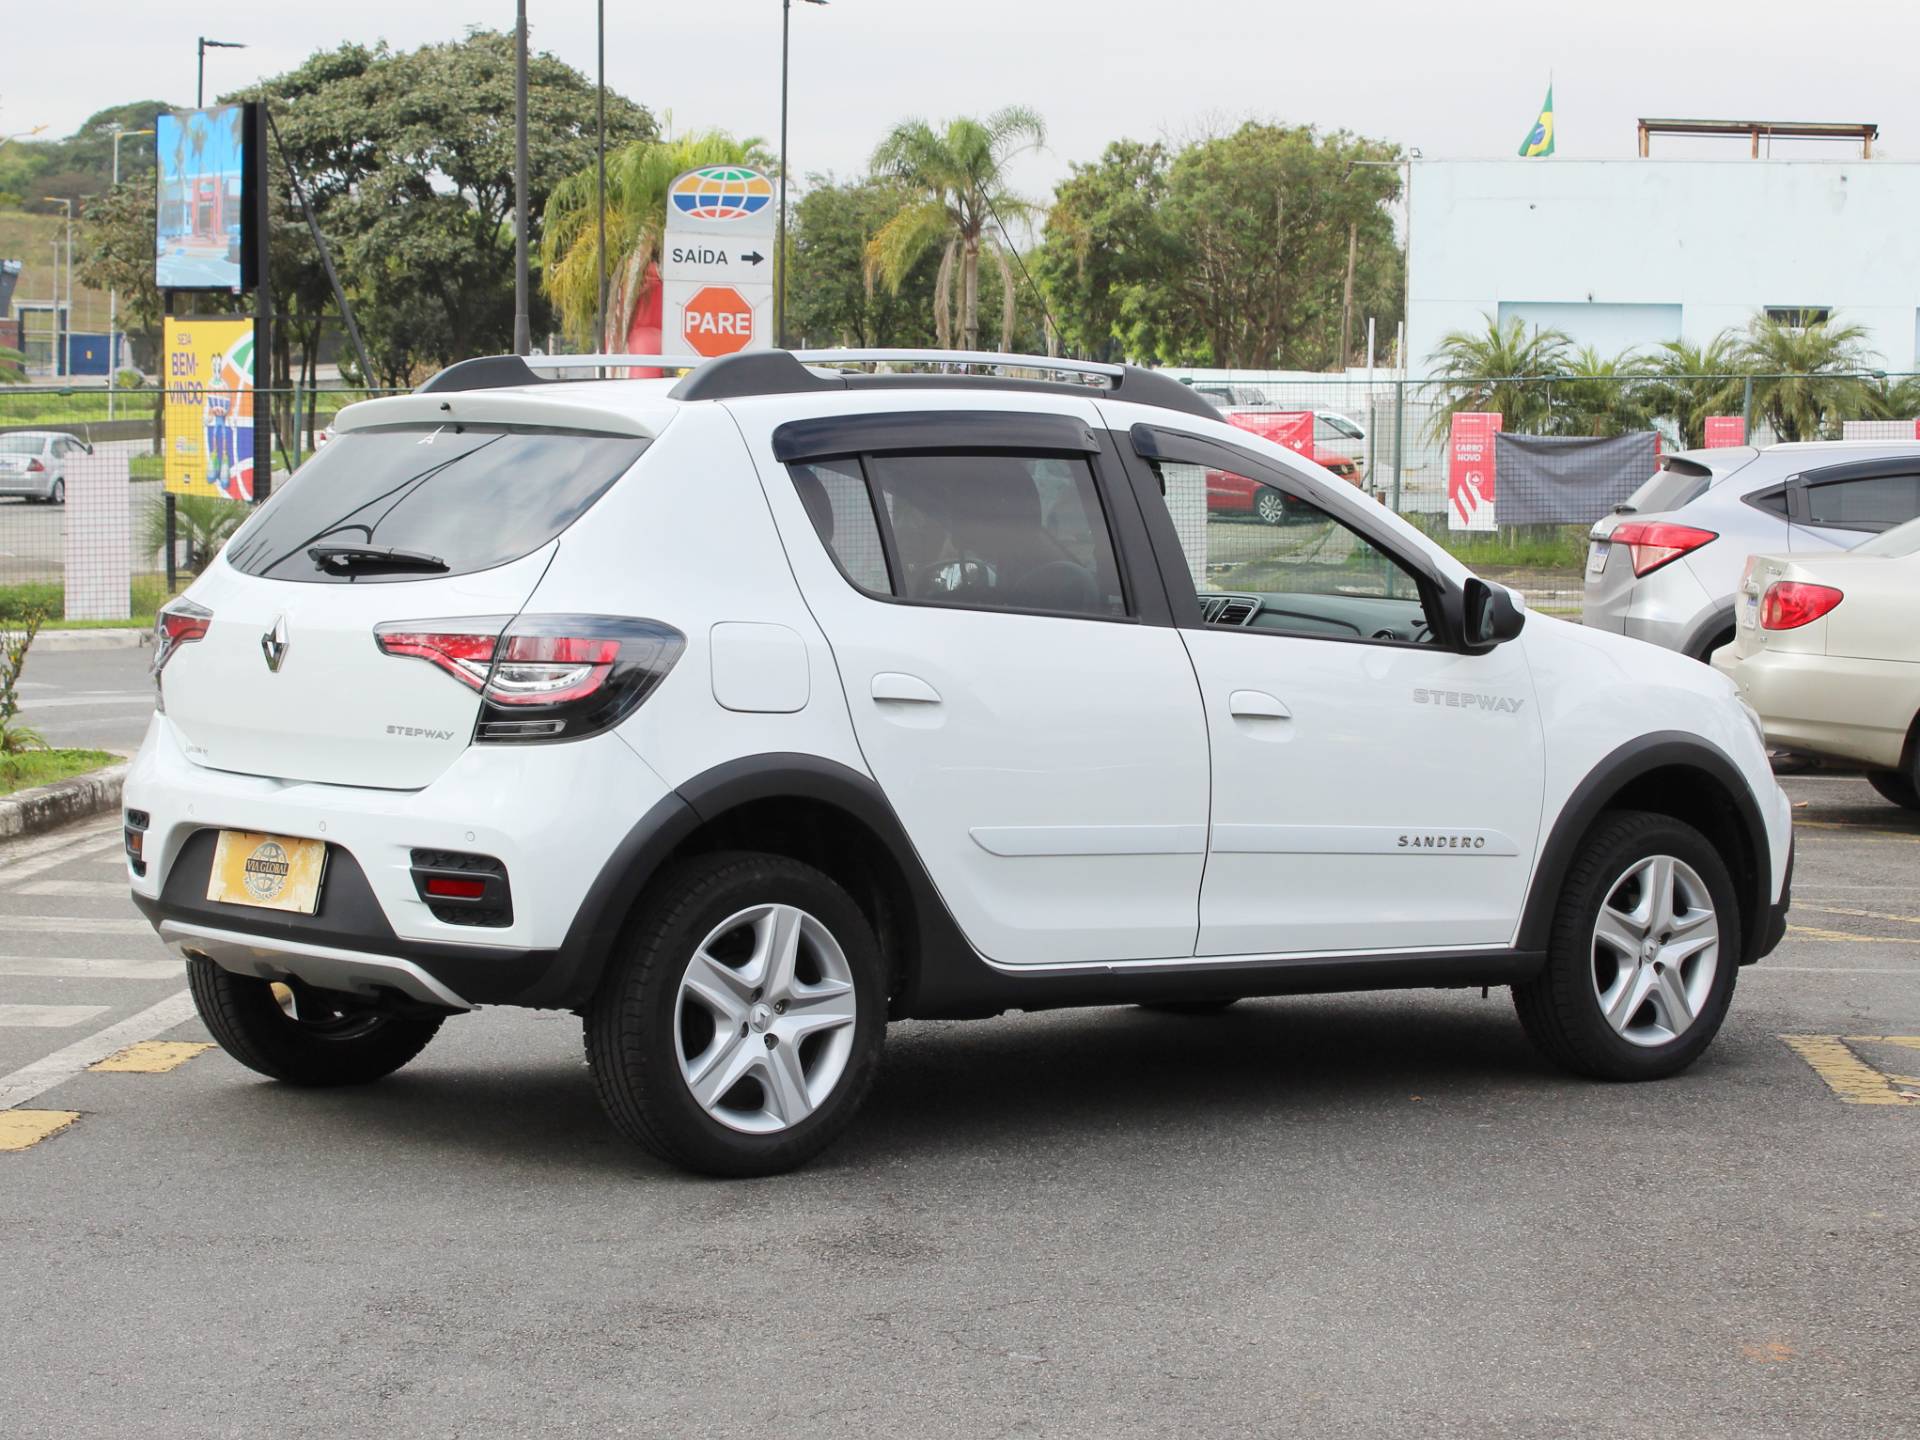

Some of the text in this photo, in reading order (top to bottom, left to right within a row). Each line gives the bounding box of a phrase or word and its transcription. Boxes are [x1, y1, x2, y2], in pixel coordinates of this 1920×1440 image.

[672, 245, 728, 265] SAÍDA
[685, 311, 750, 335] PARE
[177, 334, 192, 346] SEJA
[172, 352, 199, 376] BEM-
[168, 381, 204, 406] VINDO
[1455, 444, 1484, 452] CARRO
[1456, 454, 1481, 462] NOVO
[1413, 688, 1525, 714] STEPWAY
[386, 725, 455, 741] STEPWAY
[1397, 835, 1486, 849] SANDERO
[247, 860, 288, 875] VIA GLOBAL
